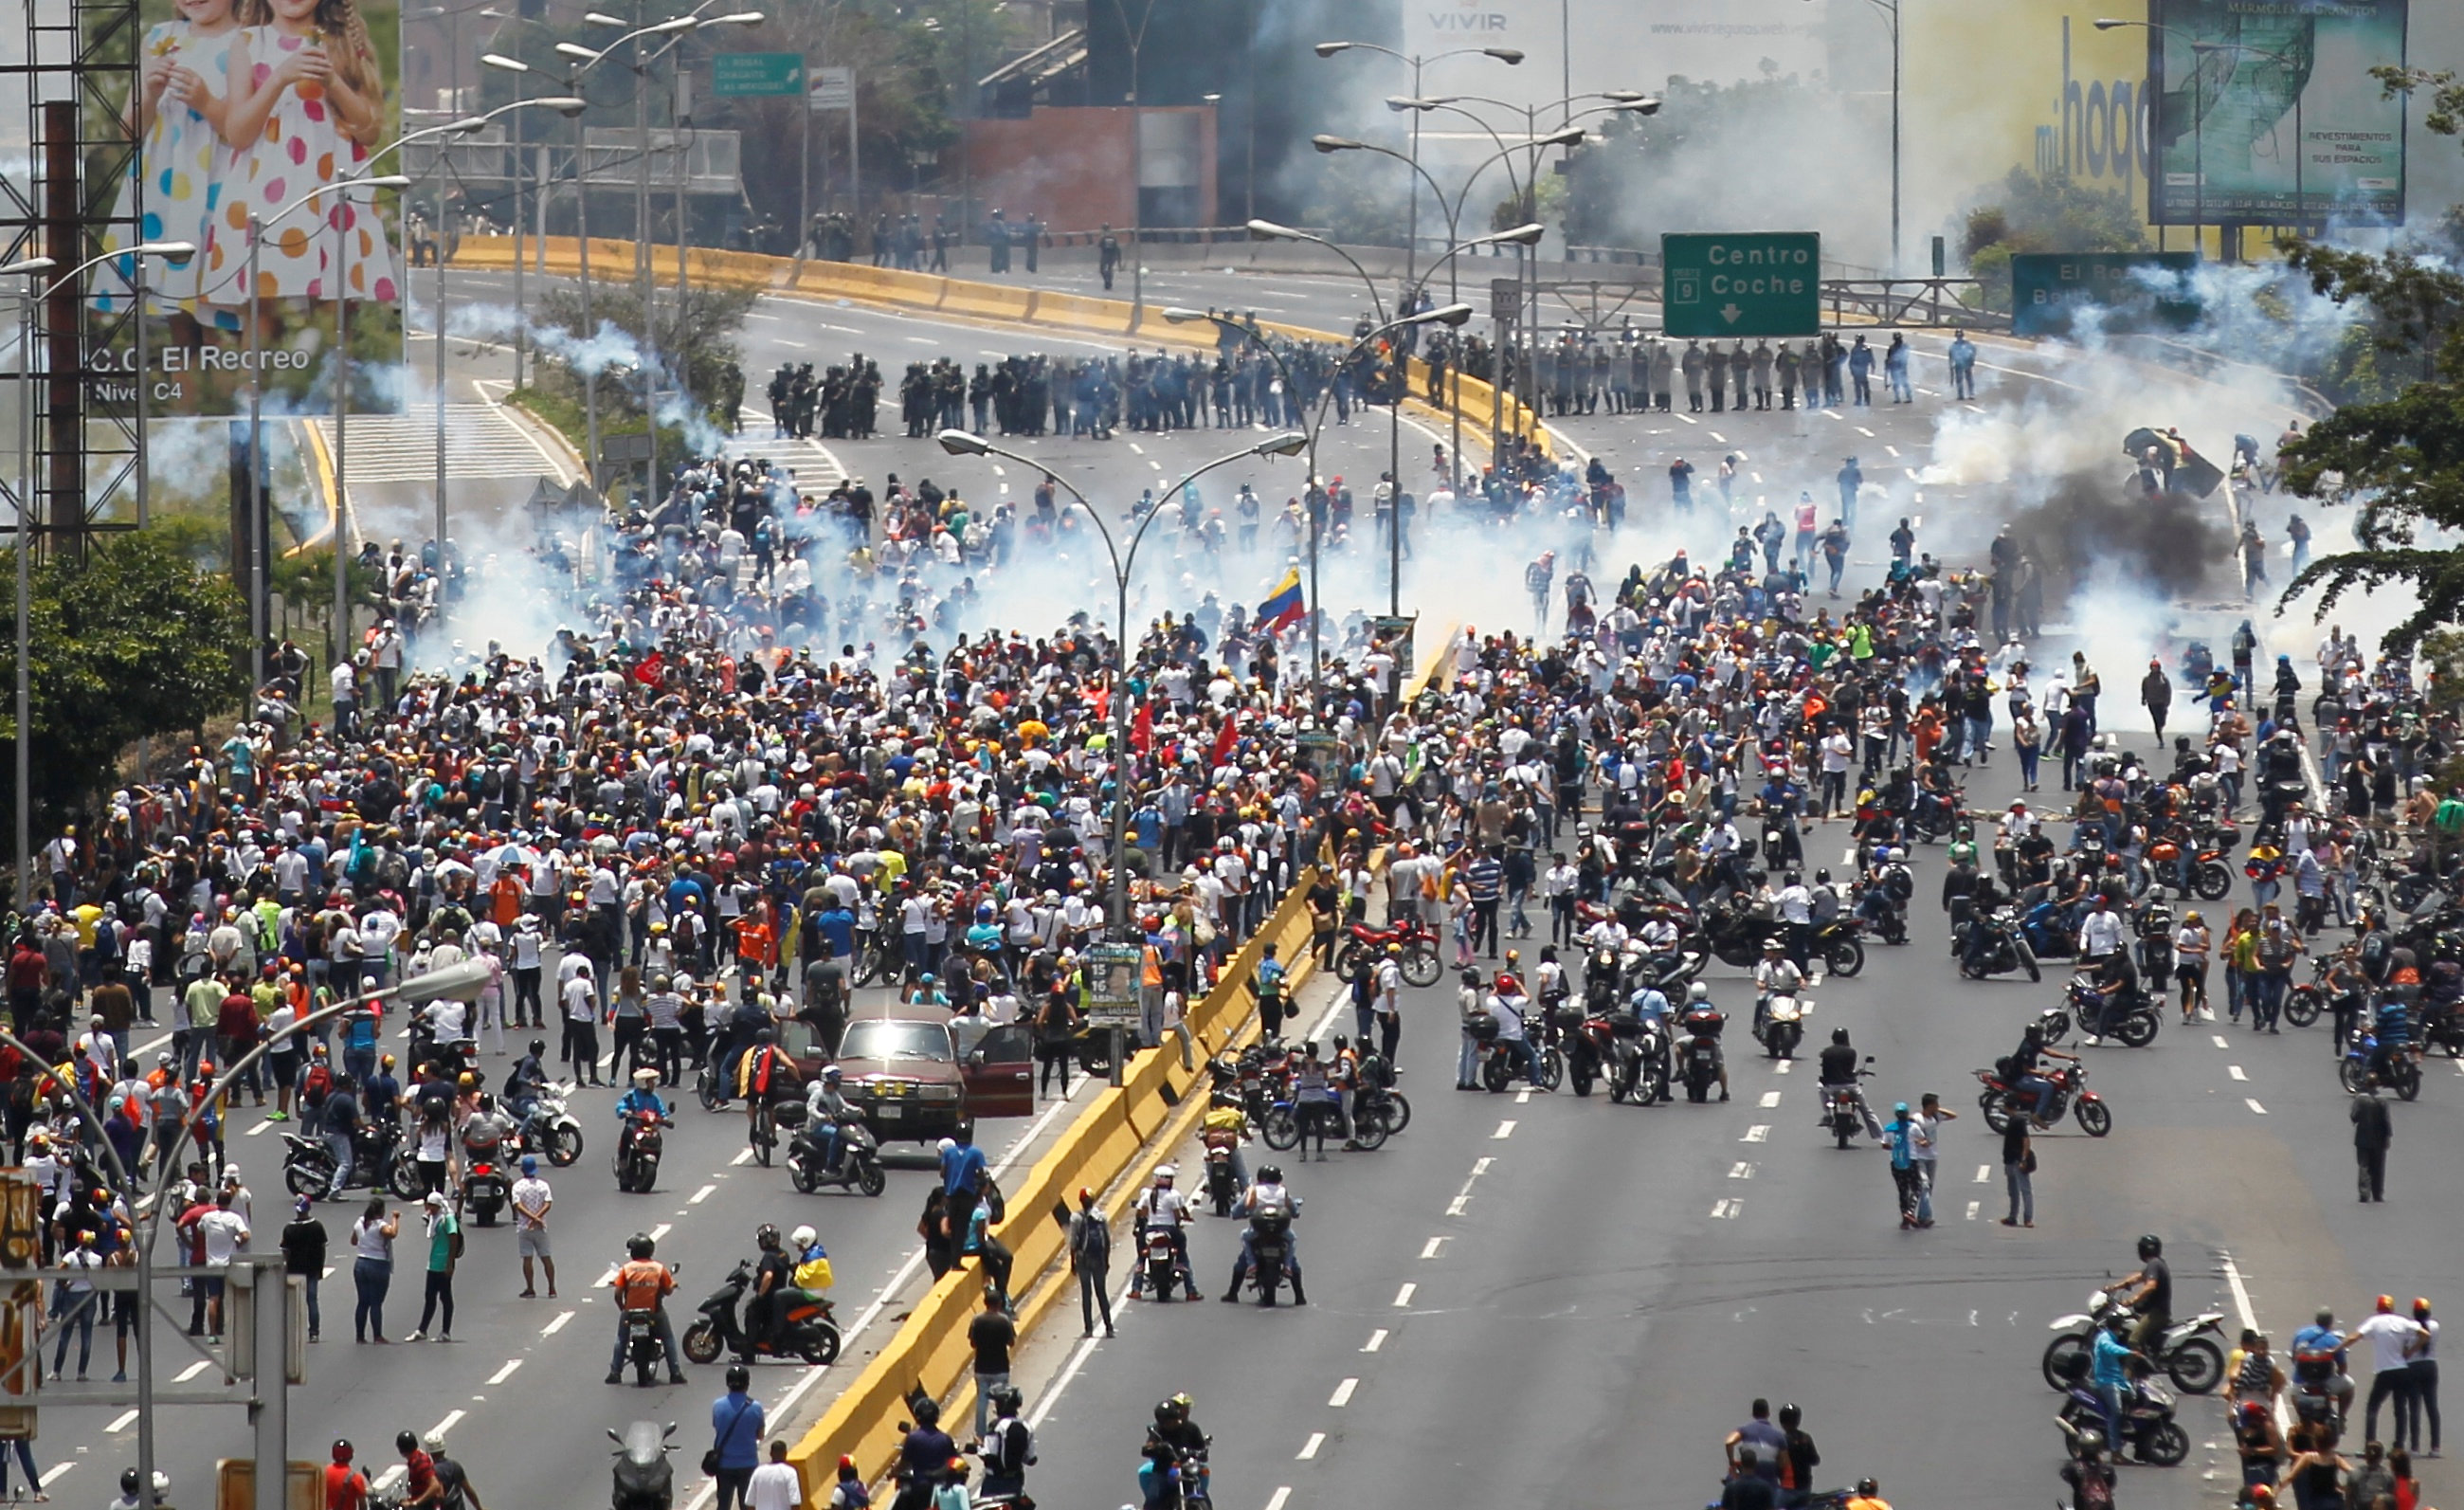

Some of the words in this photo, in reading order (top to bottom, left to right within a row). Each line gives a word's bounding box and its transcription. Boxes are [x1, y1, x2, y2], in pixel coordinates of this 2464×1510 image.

[1428, 13, 1507, 30] VIVIR
[2309, 133, 2392, 141] REVESTIMIENTOS
[2312, 155, 2331, 163] SUS
[2334, 155, 2382, 164] ESPACIOS
[1709, 245, 1808, 264] Centro
[2060, 264, 2080, 280] El
[1712, 275, 1803, 294] Coche
[162, 347, 189, 373] El
[200, 345, 310, 371] Recreo
[96, 383, 137, 402] Nive
[154, 383, 182, 401] C4
[1092, 964, 1106, 975] 15
[1092, 980, 1106, 992] 16
